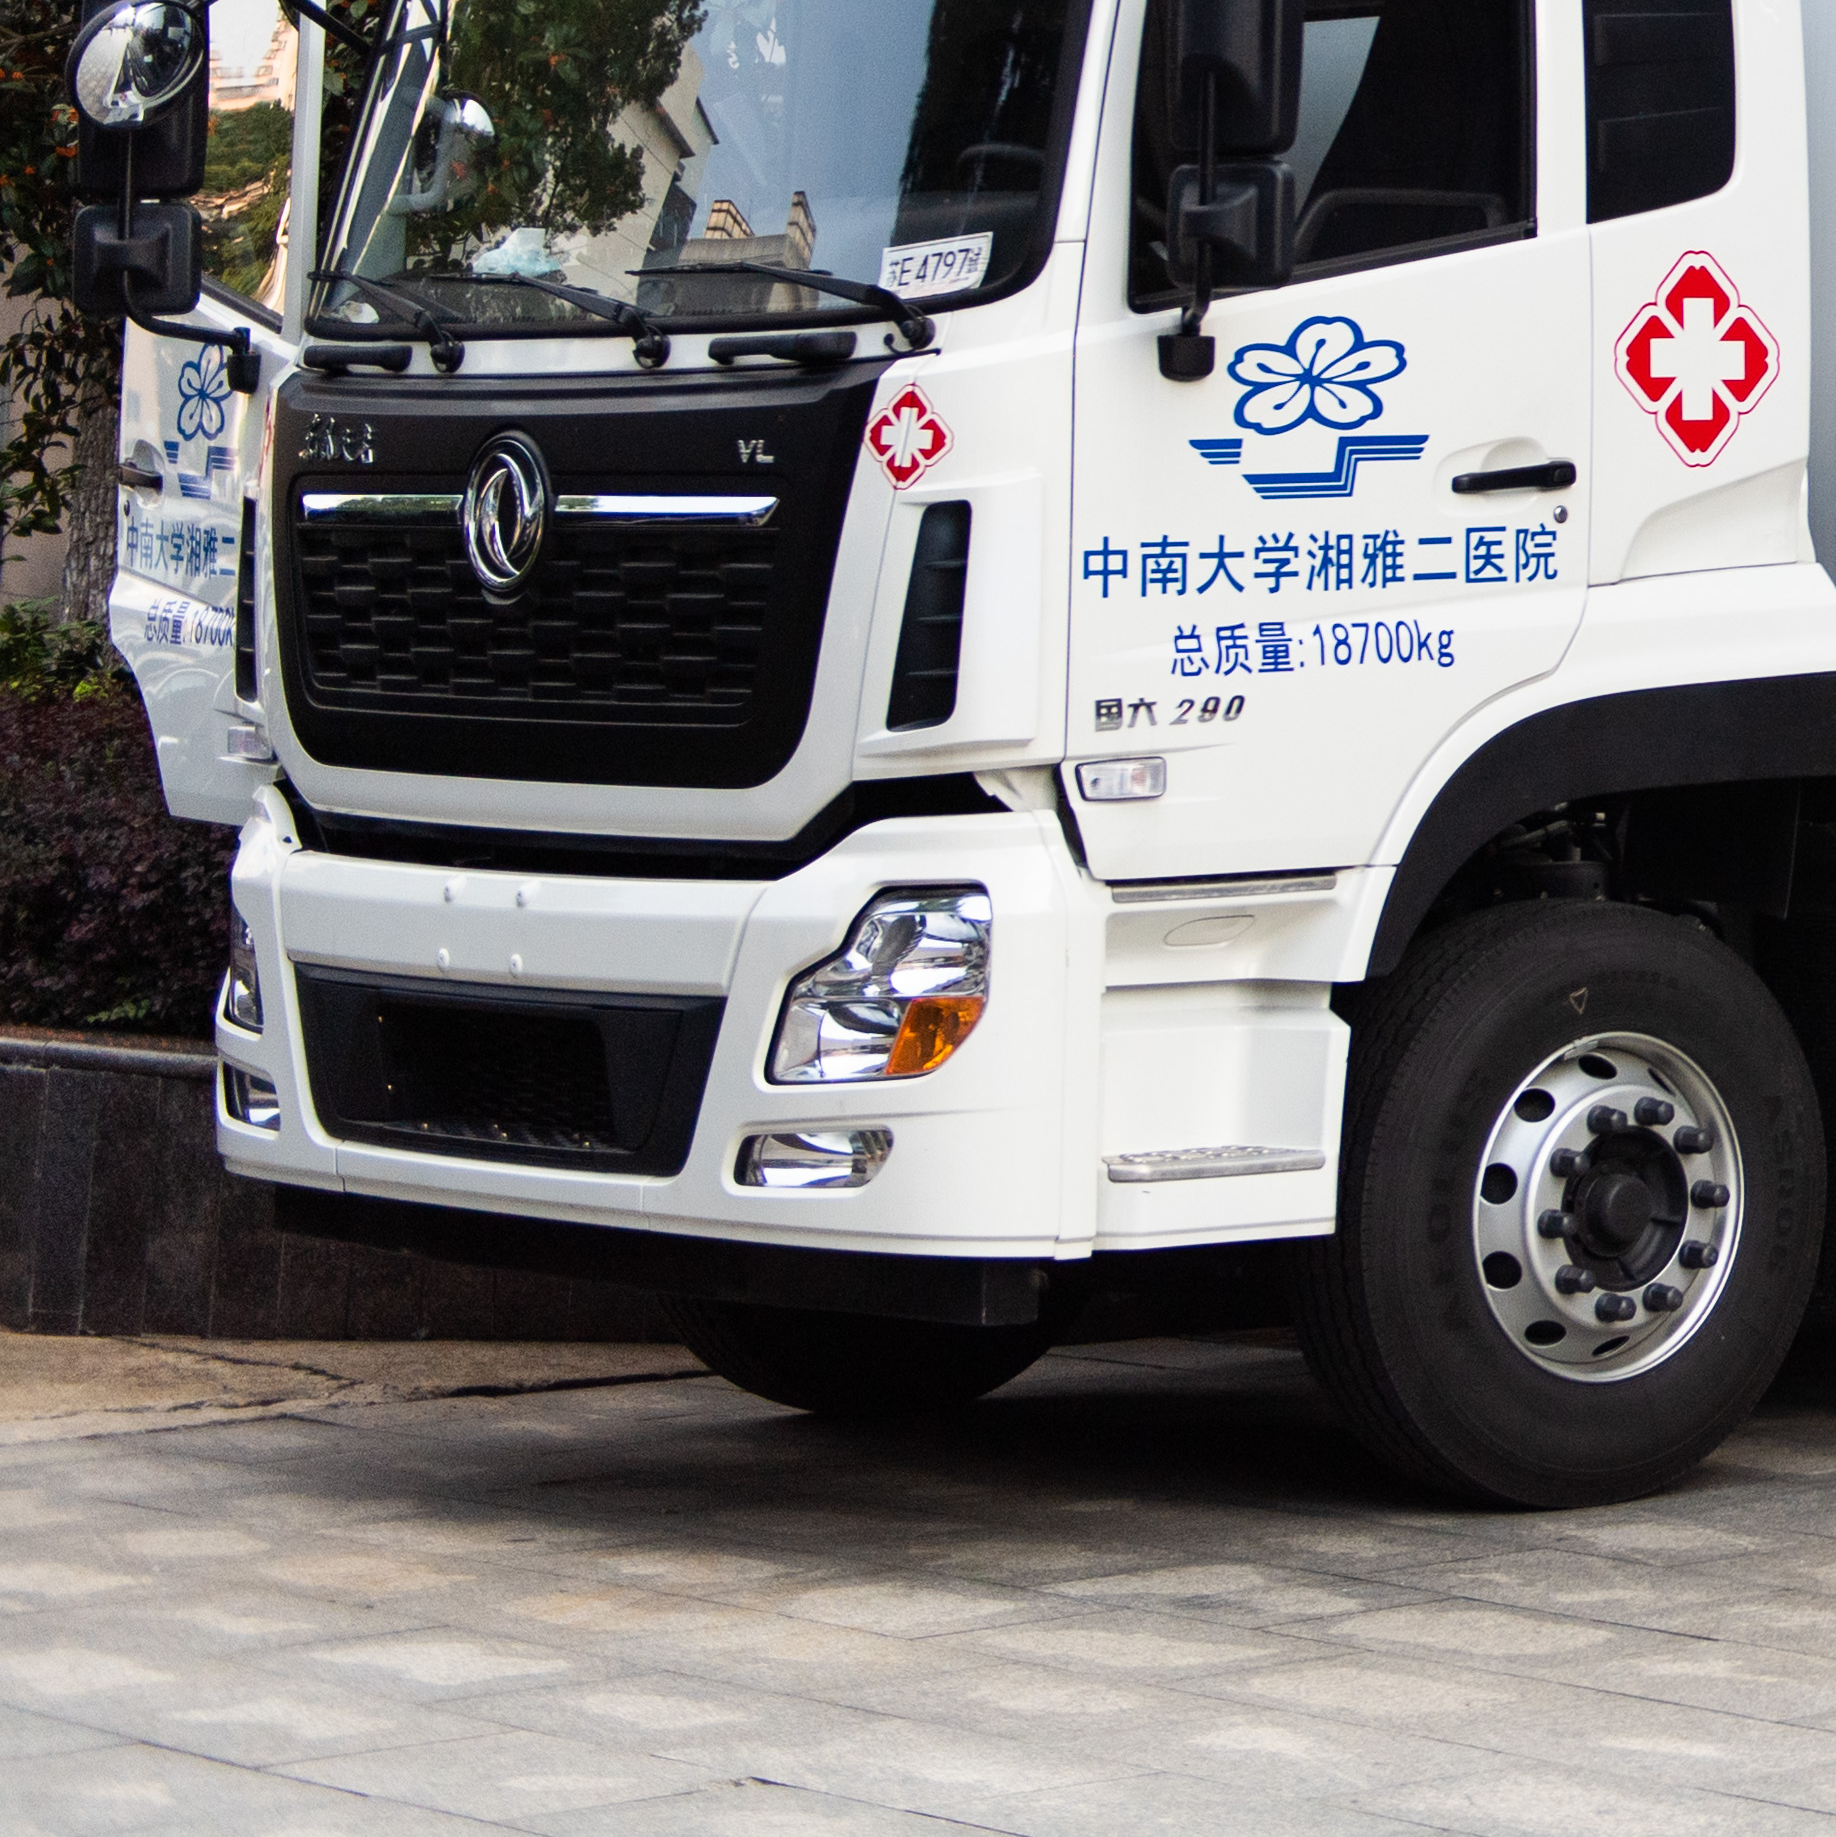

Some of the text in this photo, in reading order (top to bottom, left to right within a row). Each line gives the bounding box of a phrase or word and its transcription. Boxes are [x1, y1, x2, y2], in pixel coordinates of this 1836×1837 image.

[738, 439, 775, 463] VL
[126, 515, 236, 580] 中南大学湘雅二
[1082, 522, 1559, 599] 中南大学湘雅二医院
[1170, 618, 1456, 677] 总质量:18700kg
[1094, 697, 1158, 732] 国六
